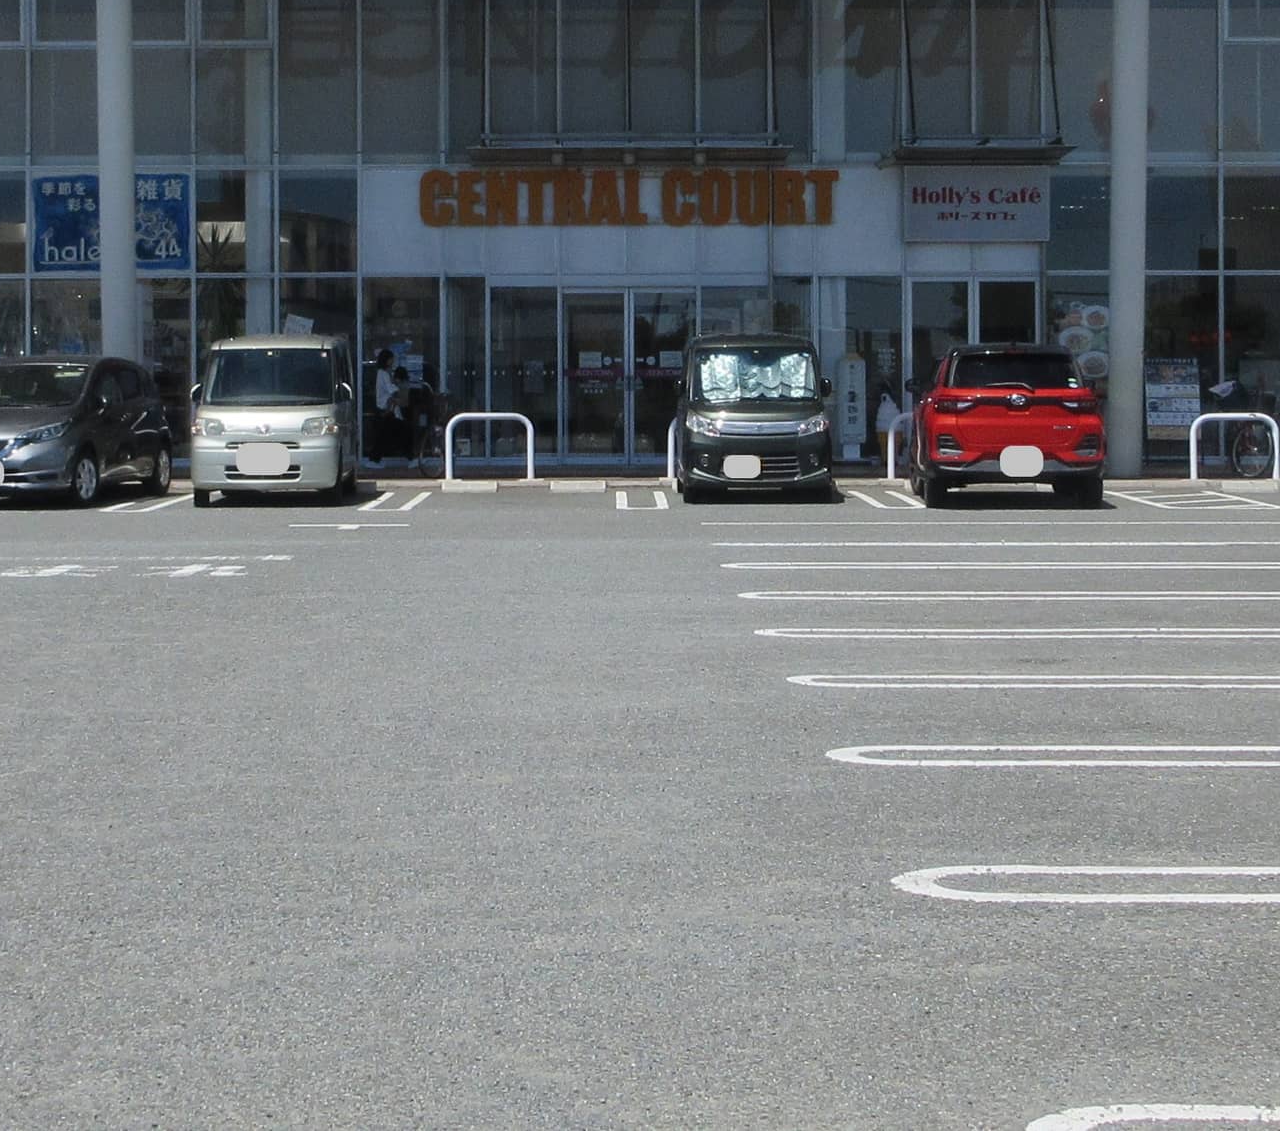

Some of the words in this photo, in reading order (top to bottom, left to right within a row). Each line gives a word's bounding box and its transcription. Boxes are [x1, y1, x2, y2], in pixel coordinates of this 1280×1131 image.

[136, 179, 184, 201] 雑貨
[419, 169, 649, 227] CENTRAL
[662, 169, 840, 227] COURT
[911, 185, 981, 207] Holly's
[987, 185, 1042, 204] Café
[154, 240, 182, 259] 44
